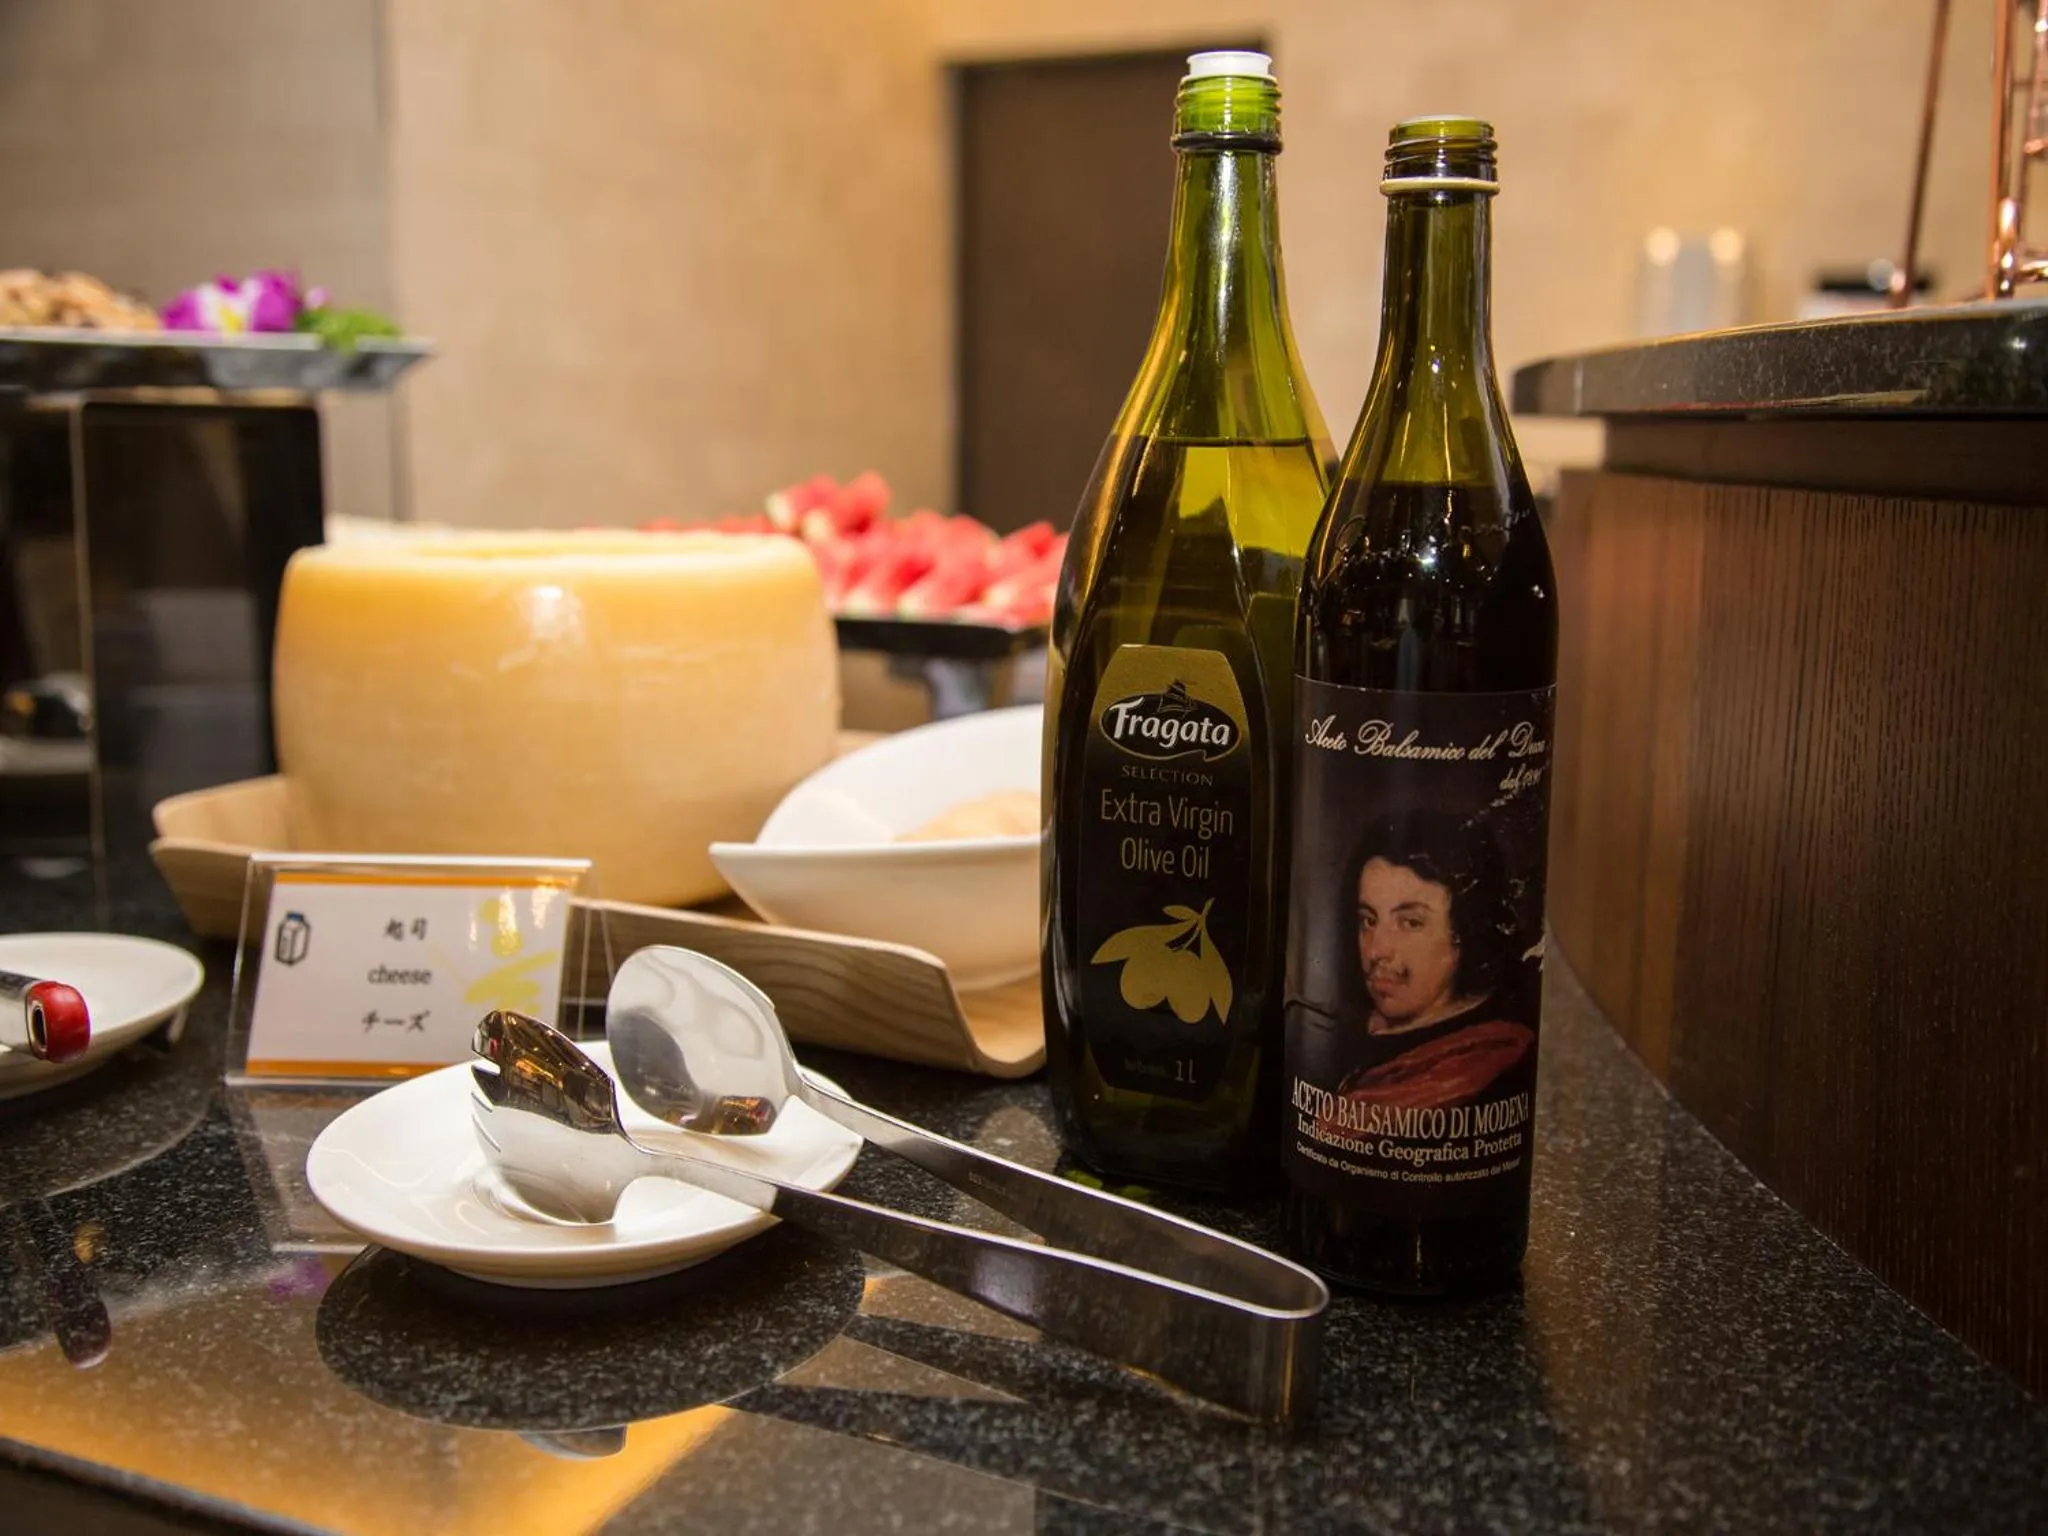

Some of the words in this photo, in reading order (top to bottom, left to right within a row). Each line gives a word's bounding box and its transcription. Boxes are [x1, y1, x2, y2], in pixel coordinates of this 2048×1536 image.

[1110, 696, 1230, 748] Fragata
[1305, 714, 1347, 751] Aceto
[1354, 719, 1466, 761] Balsamico
[1468, 729, 1508, 760] del
[1121, 764, 1214, 787] SELECTION
[1101, 788, 1161, 827] Extra
[1168, 794, 1234, 841] Virgin
[1121, 836, 1175, 875] Olive
[1181, 844, 1210, 881] Oil
[367, 963, 433, 986] cheese
[361, 1009, 431, 1033] チーズ
[1291, 1075, 1334, 1122] ACETO
[1337, 1093, 1447, 1140] BALSAMICO
[1450, 1106, 1469, 1139] DI
[1297, 1112, 1375, 1156] Indicazione
[1378, 1139, 1470, 1168] Geografica
[1473, 1131, 1523, 1160] Protetta
[1340, 1159, 1389, 1180] Organismo
